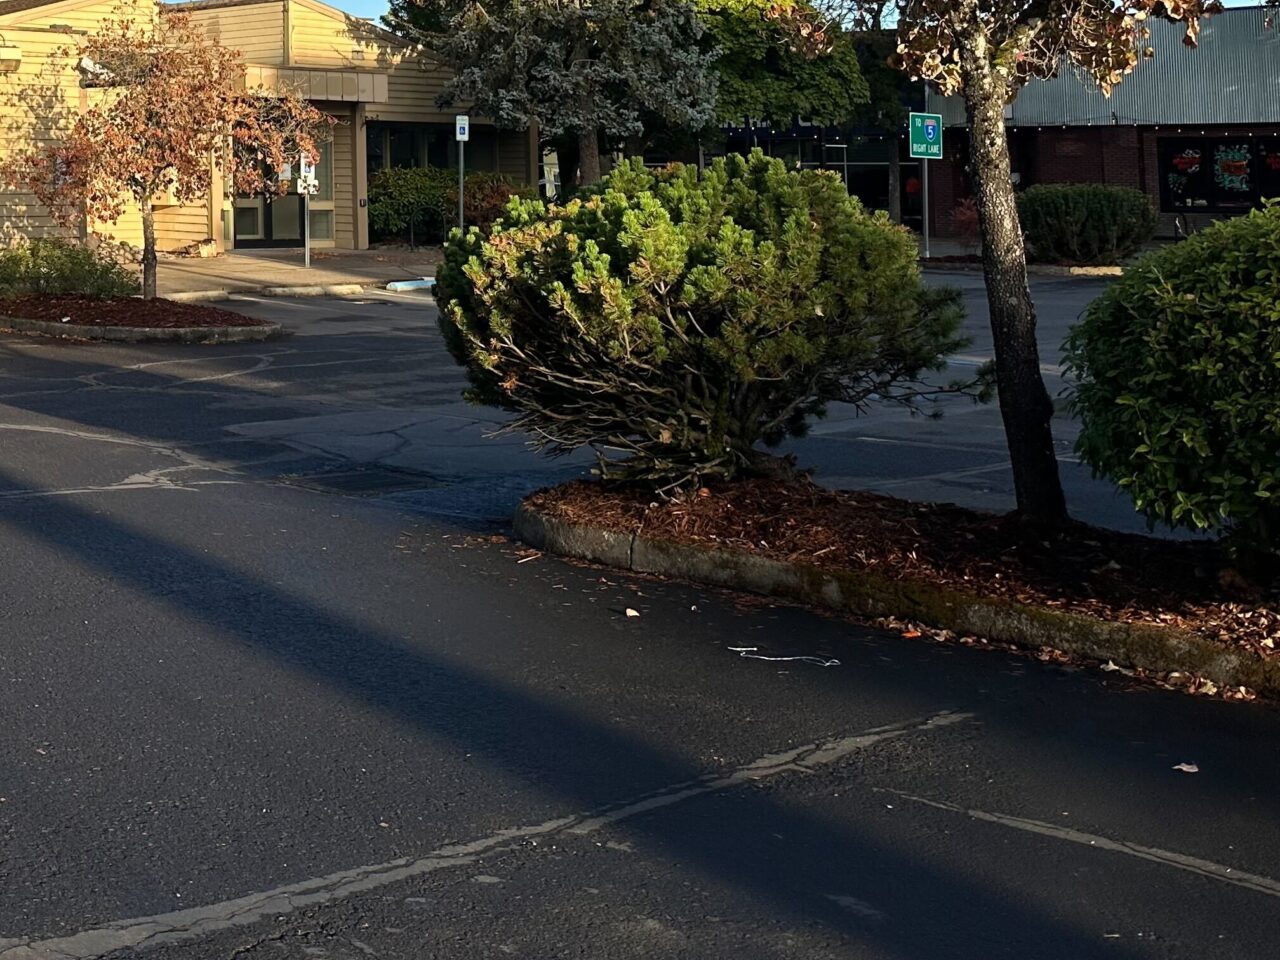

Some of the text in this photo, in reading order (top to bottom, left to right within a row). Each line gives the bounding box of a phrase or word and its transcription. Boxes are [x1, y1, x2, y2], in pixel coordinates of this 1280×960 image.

[915, 118, 922, 127] TO
[928, 126, 934, 138] 5
[913, 143, 939, 153] RIGHT LANE
